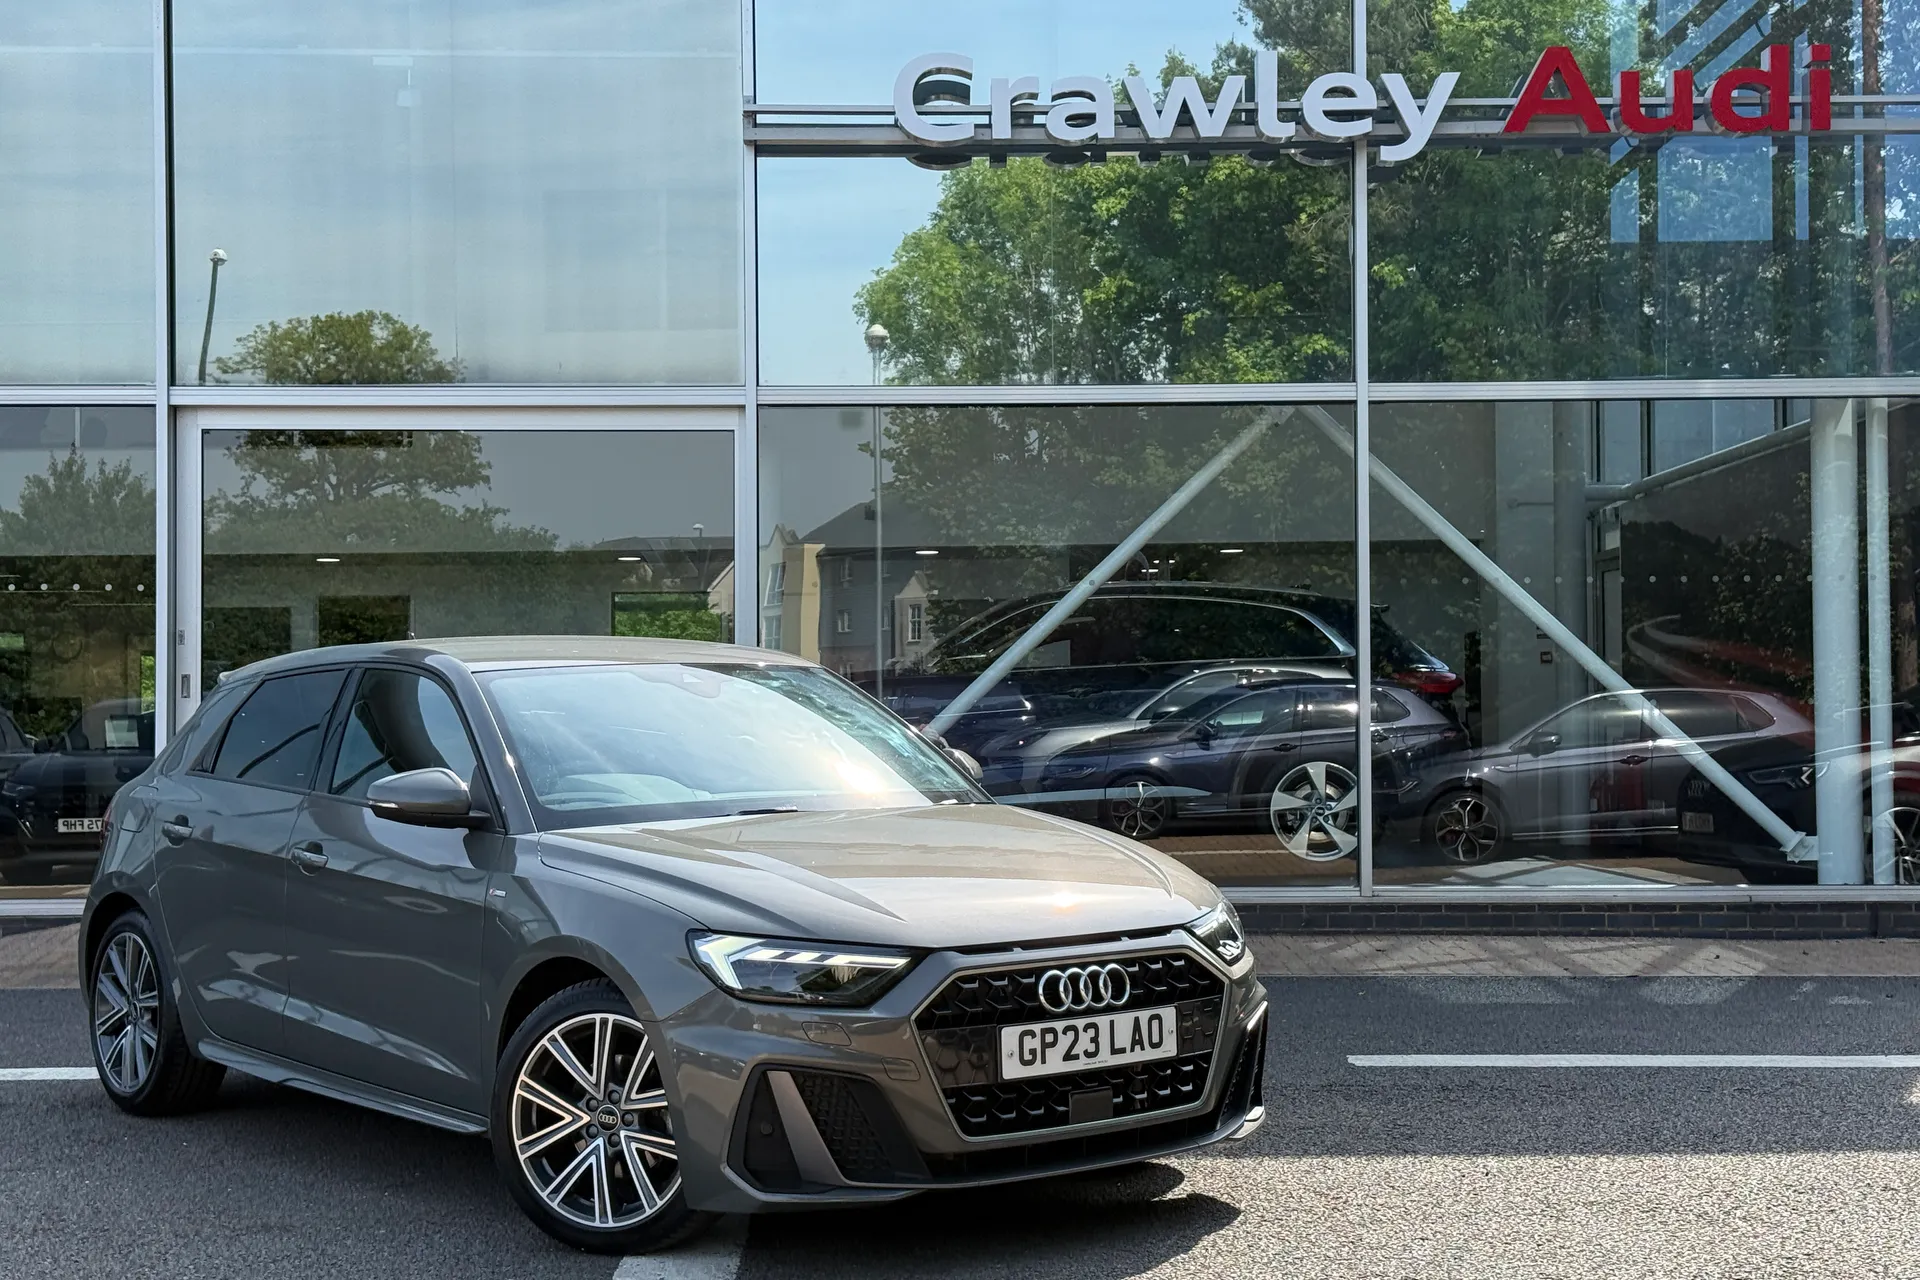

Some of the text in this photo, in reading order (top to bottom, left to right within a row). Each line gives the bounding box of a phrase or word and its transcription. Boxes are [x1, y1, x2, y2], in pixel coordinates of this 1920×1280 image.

[893, 44, 1832, 162] Crawley Audi
[1018, 1013, 1163, 1067] GP23 LAO
